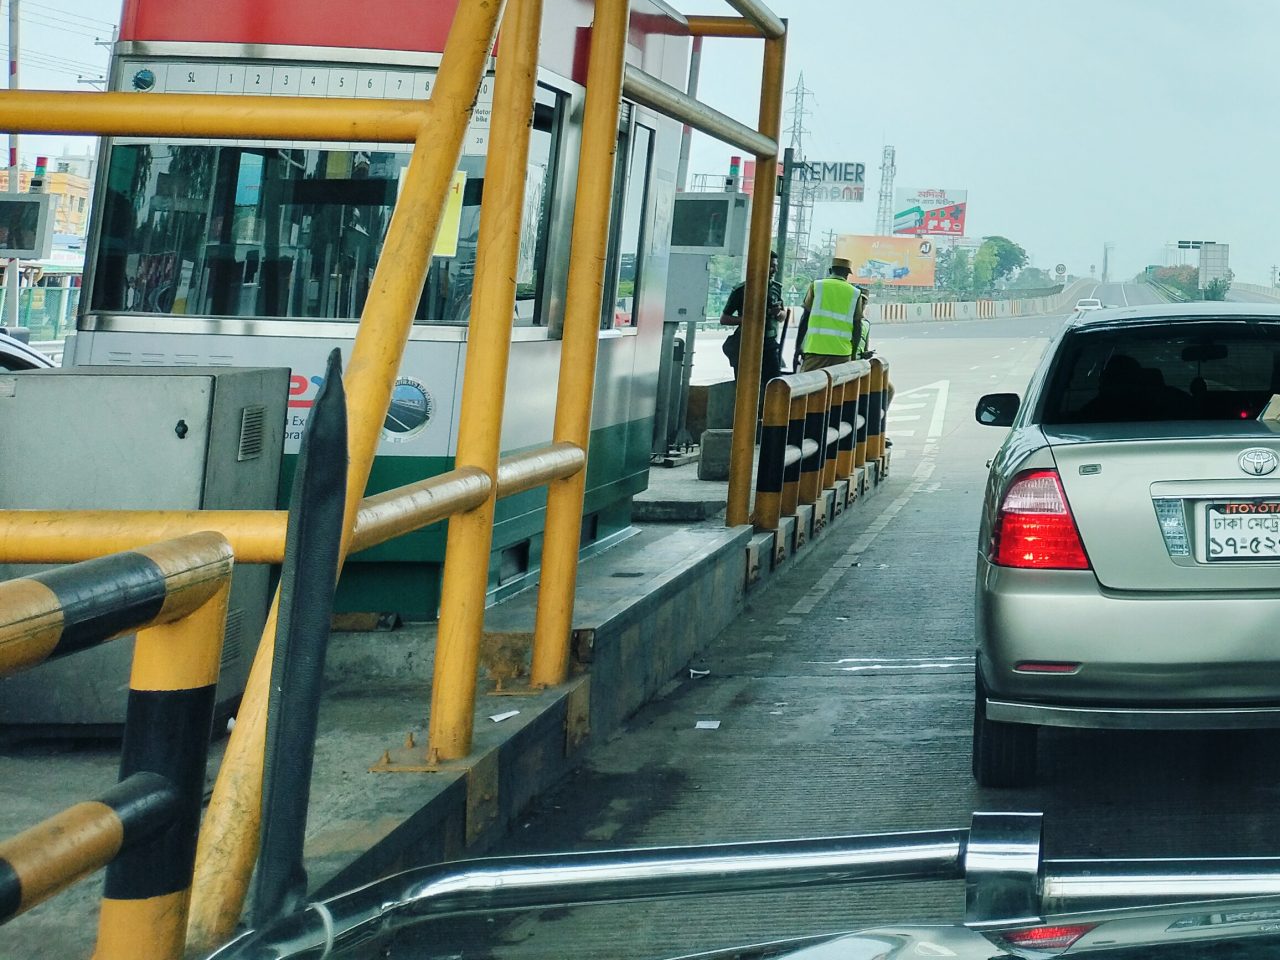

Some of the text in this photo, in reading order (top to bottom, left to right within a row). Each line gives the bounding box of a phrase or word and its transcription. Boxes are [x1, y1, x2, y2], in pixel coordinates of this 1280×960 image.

[187, 71, 196, 84] SL
[229, 73, 233, 84] 1
[255, 73, 261, 85] 2
[283, 75, 289, 86] 3
[311, 76, 316, 87] 4
[339, 77, 344, 88] 5
[367, 77, 373, 89] 6
[397, 79, 402, 90] 7
[425, 81, 430, 91] 8
[1213, 516, 1243, 531] ঢাকা
